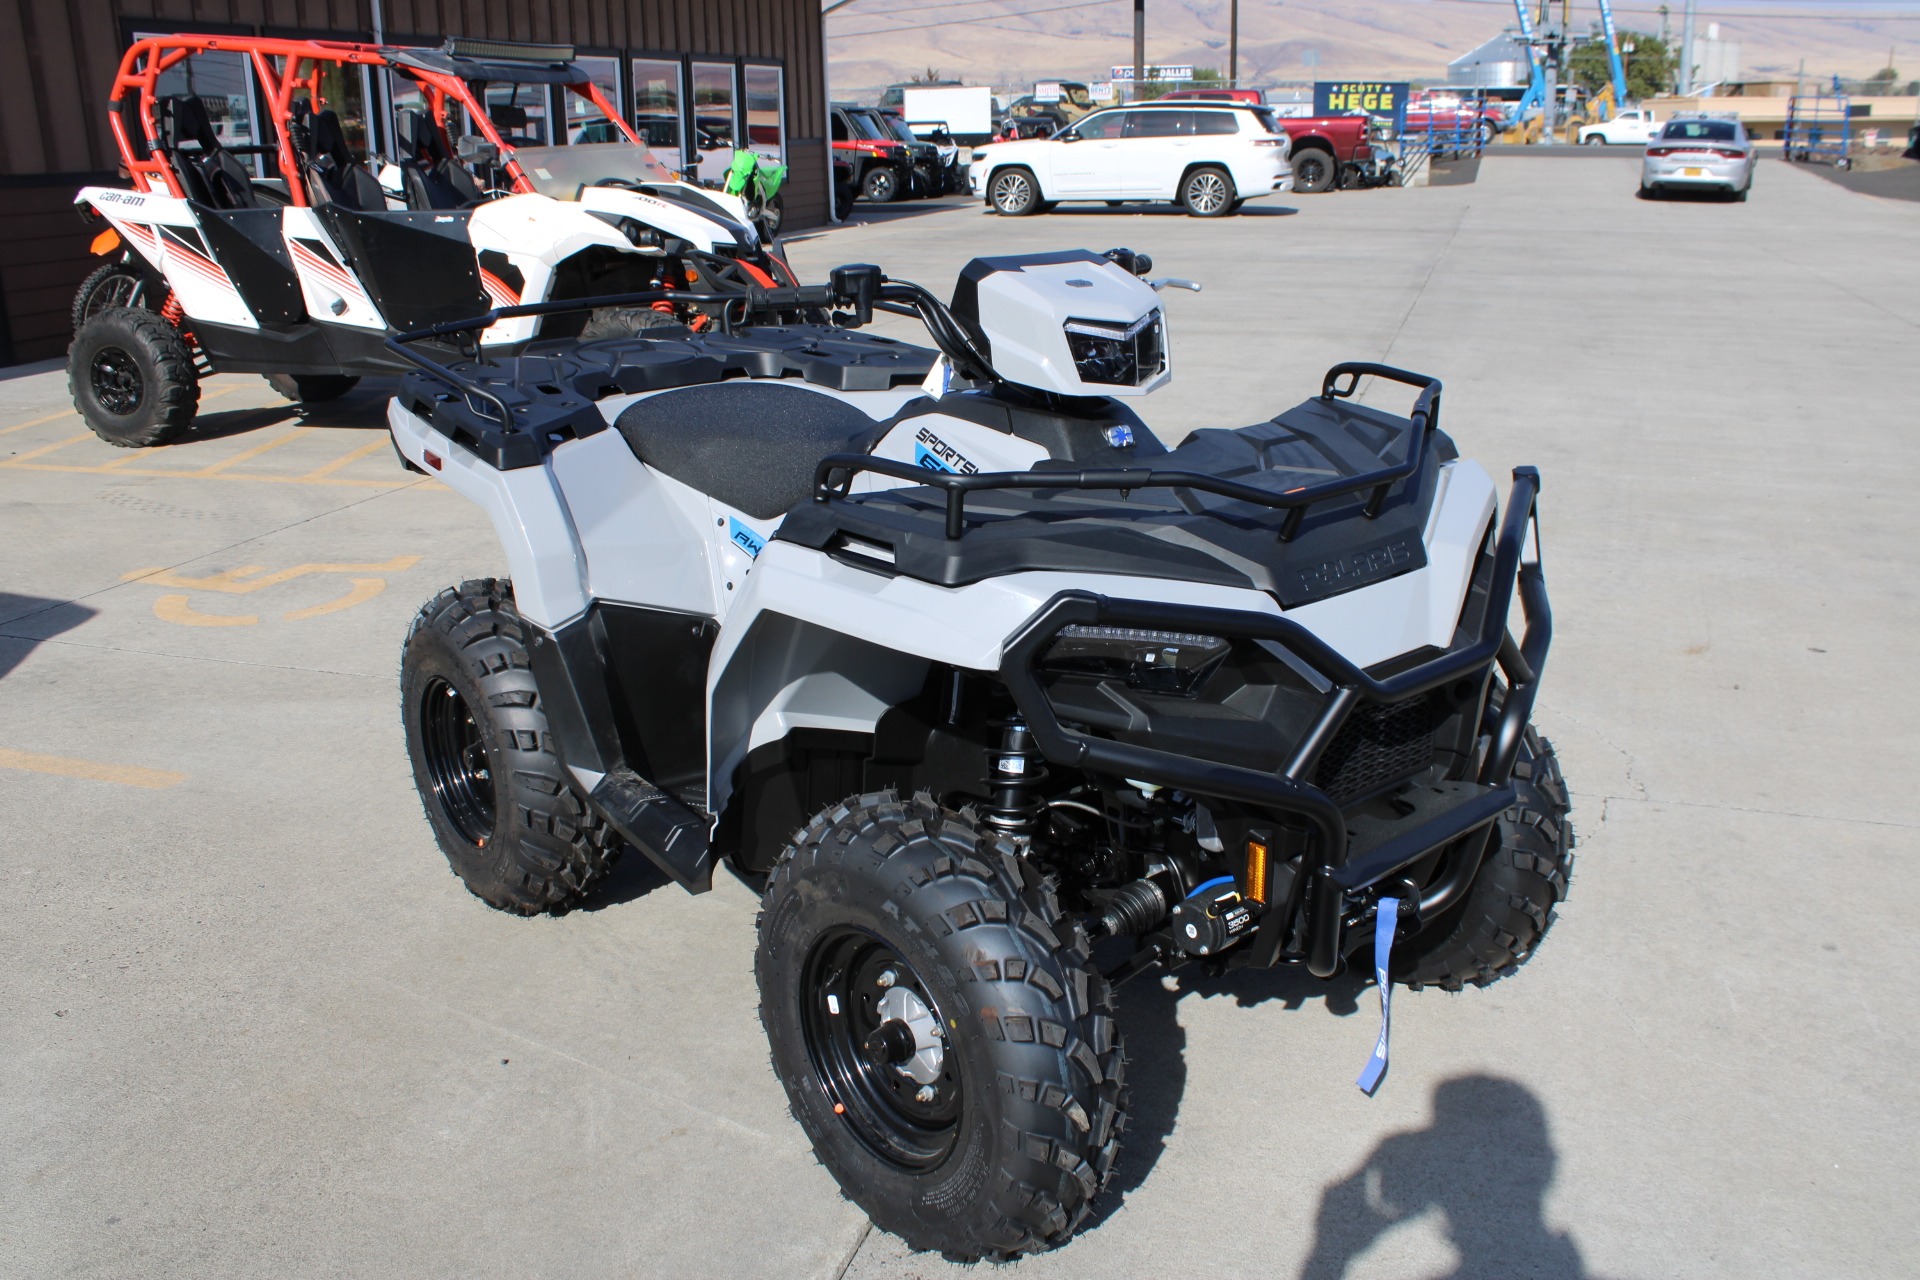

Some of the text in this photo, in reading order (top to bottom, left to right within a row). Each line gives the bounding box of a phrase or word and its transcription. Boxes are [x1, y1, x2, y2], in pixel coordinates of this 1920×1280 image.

[1160, 68, 1191, 77] DALLES
[1341, 84, 1382, 93] SCOTT
[1329, 93, 1394, 110] HEGE
[99, 191, 145, 207] can-am
[734, 531, 762, 555] AW
[1297, 541, 1410, 591] POLARIS
